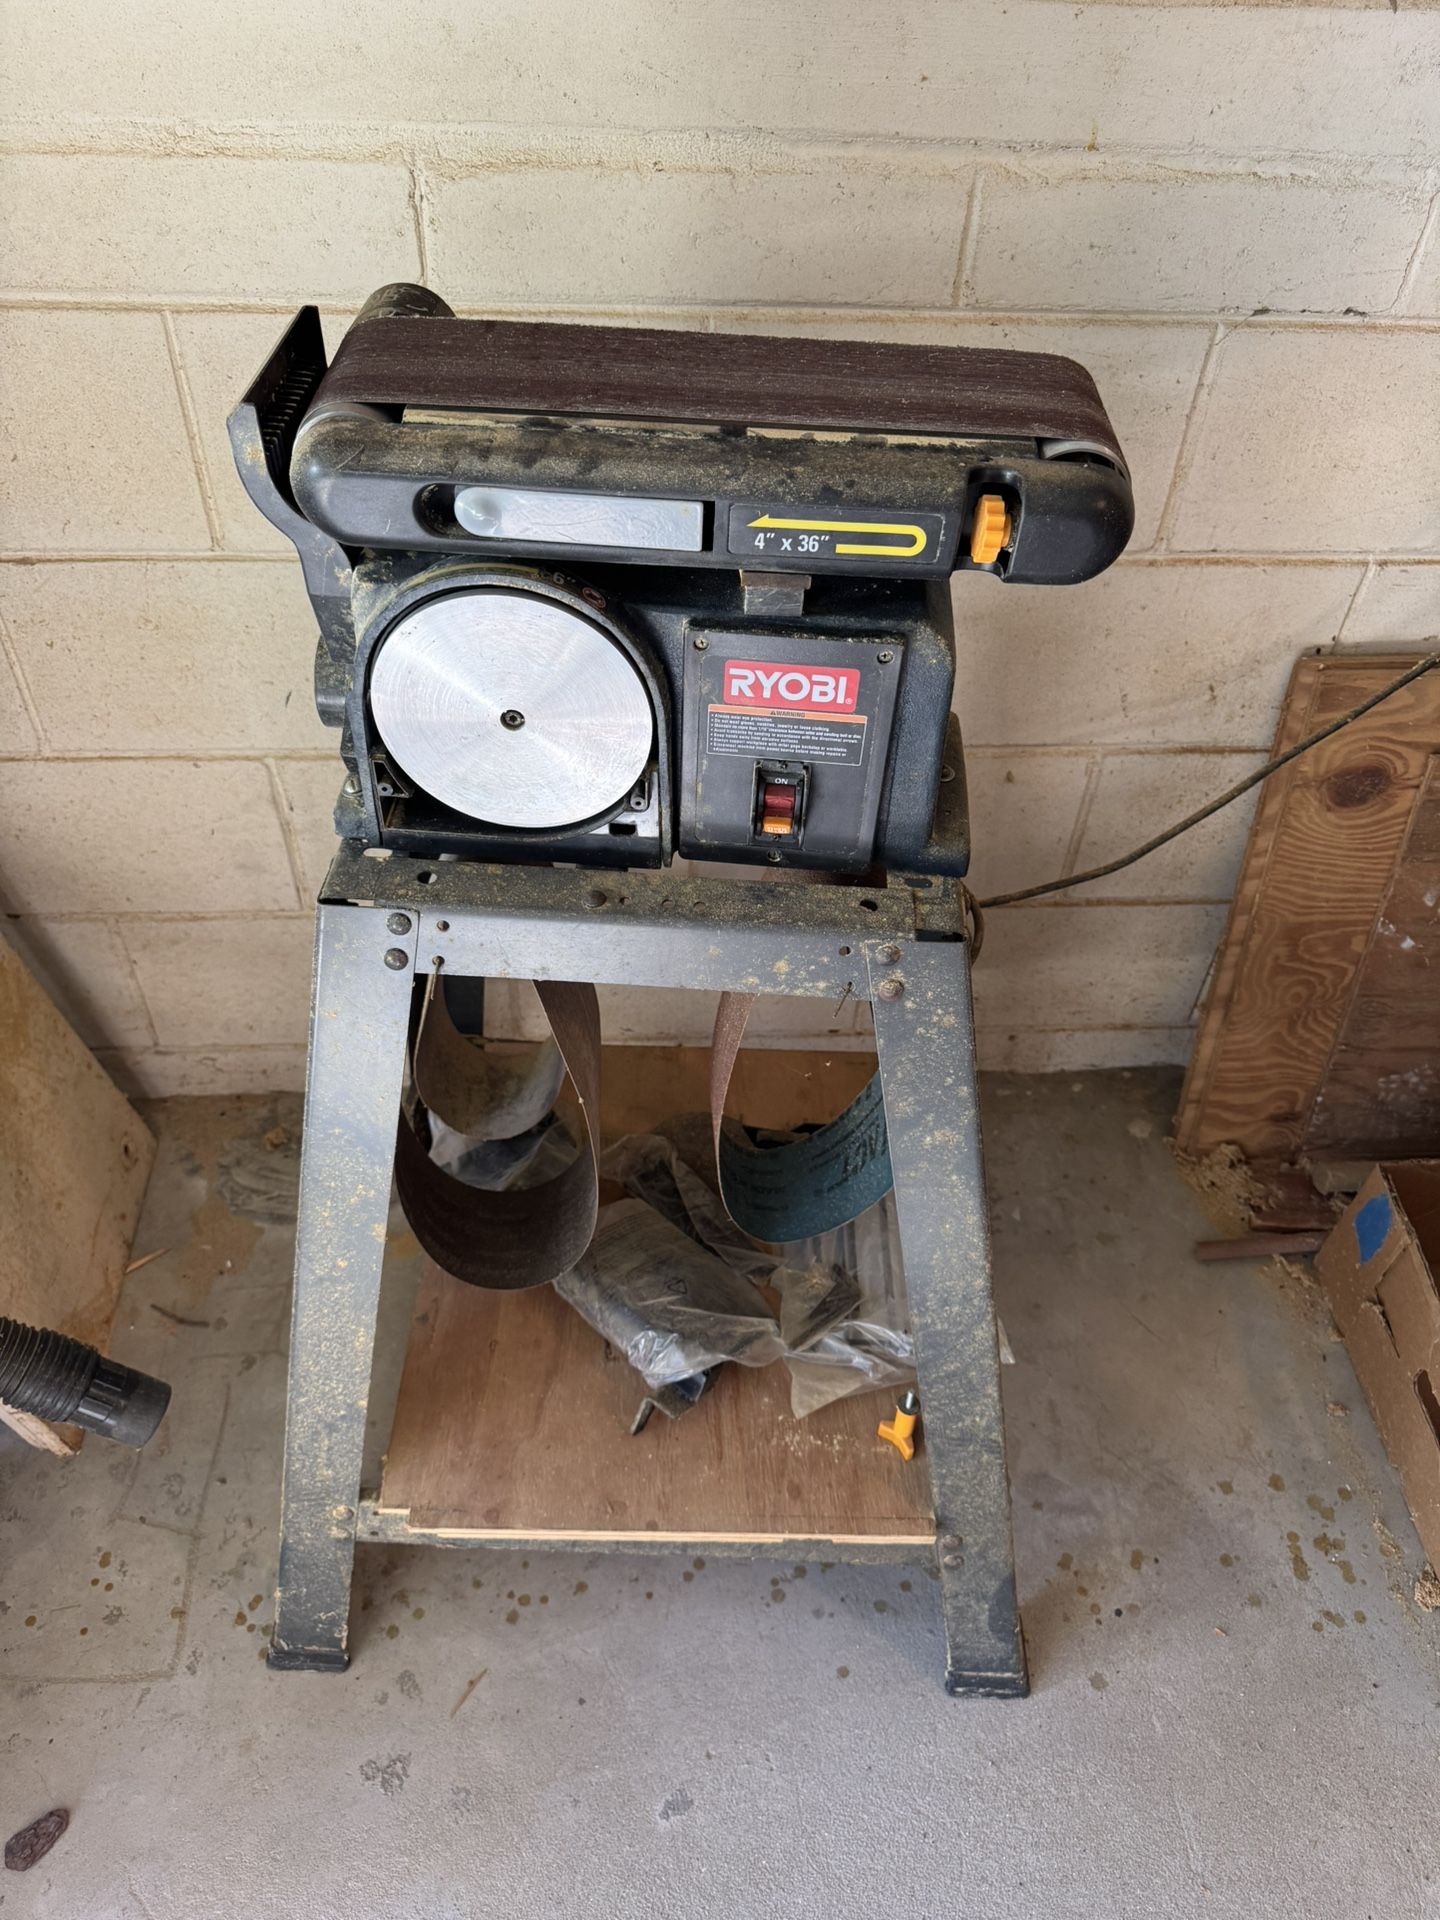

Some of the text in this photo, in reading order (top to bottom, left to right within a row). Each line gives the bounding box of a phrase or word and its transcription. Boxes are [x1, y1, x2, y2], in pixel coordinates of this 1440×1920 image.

[754, 532, 830, 553] 4" x 36"
[729, 668, 847, 704] RYOBI
